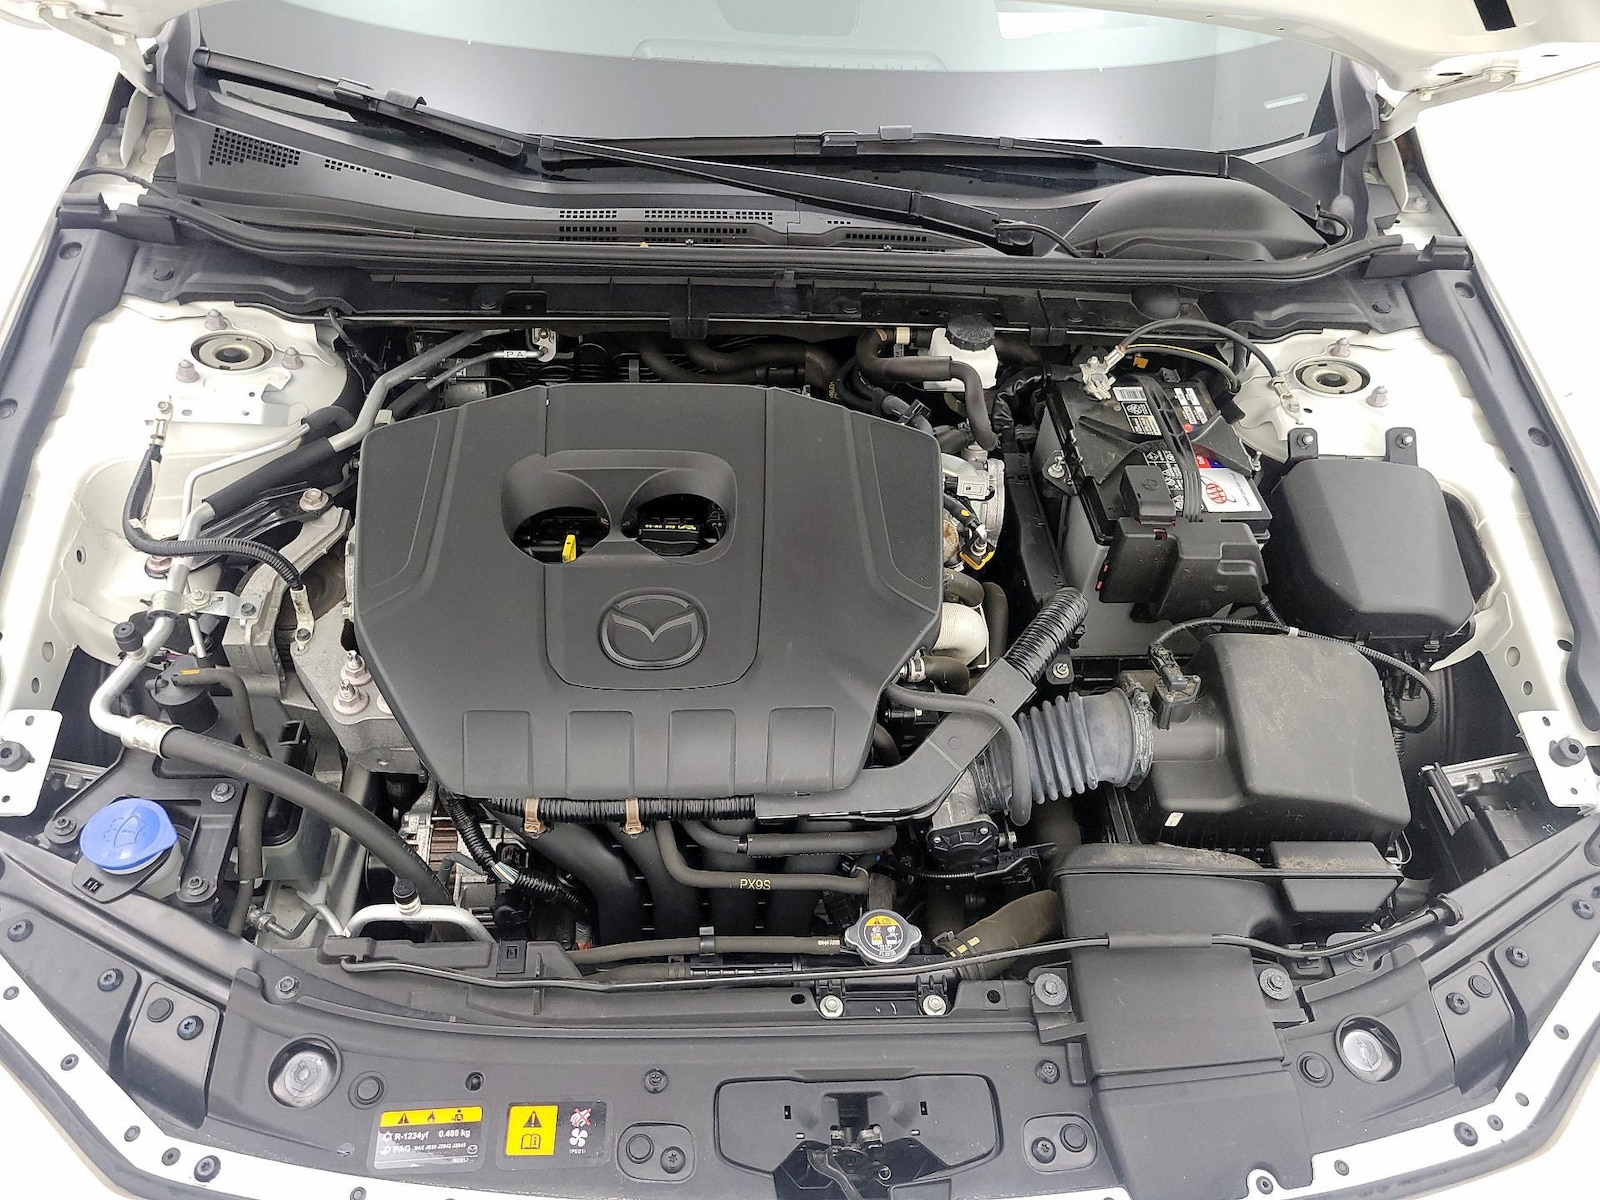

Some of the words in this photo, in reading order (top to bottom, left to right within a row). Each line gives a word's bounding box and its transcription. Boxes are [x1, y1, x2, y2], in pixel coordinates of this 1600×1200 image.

[740, 878, 770, 890] PX9S
[394, 1130, 430, 1141] R-1234yf
[460, 1128, 471, 1138] kg
[392, 1144, 411, 1154] PAG
